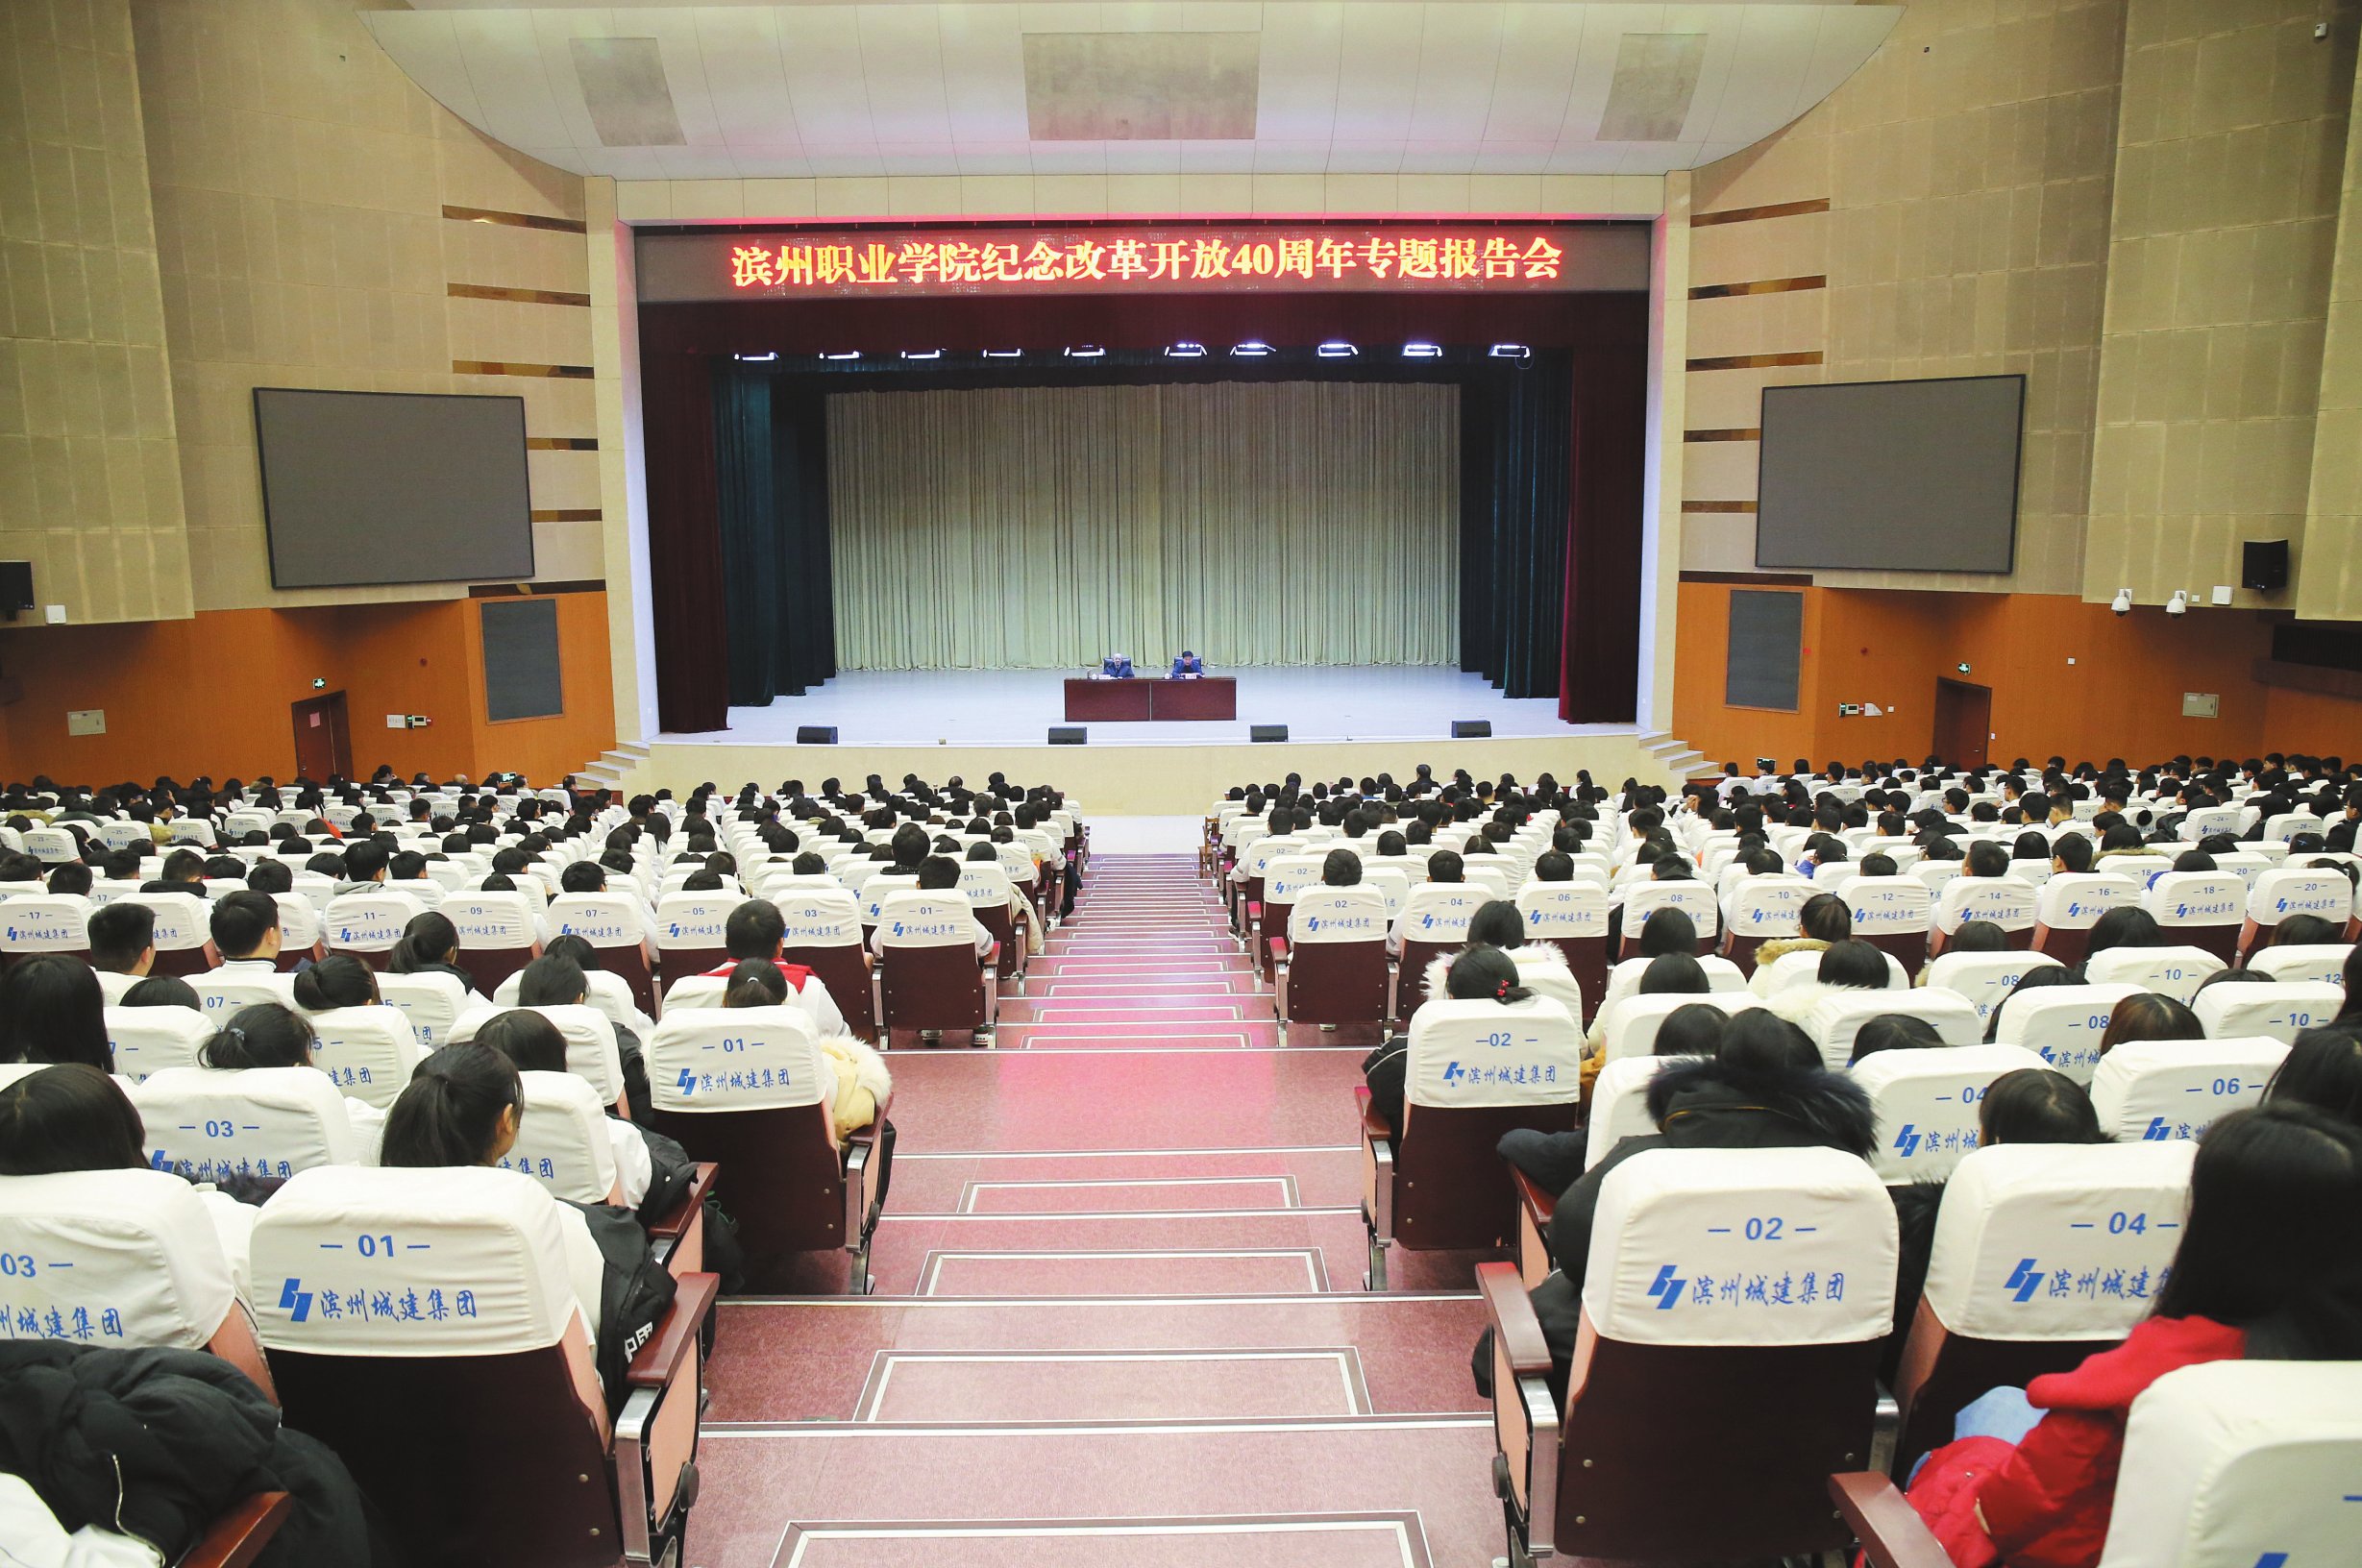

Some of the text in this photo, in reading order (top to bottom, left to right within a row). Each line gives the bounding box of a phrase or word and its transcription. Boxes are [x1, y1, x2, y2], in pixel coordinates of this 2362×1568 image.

[731, 236, 1562, 287] 滨州职业学院纪念改革开放40周年专题报告会
[1779, 891, 1790, 899] 10
[2204, 886, 2215, 894] 18
[1671, 894, 1684, 903] 08
[29, 911, 40, 919] 17
[471, 906, 482, 916] 09
[585, 909, 597, 918] 07
[692, 907, 705, 916] 05
[804, 909, 818, 918] 03
[920, 906, 932, 915] 01
[681, 924, 727, 937] 滨州城建集
[2002, 974, 2019, 987] 08
[2165, 968, 2182, 981] 10
[2325, 972, 2342, 985] 12
[207, 995, 224, 1009] 07
[2088, 1015, 2109, 1030] 08
[2289, 1013, 2310, 1027] 10
[723, 1038, 745, 1053] 01
[1489, 1032, 1512, 1047] 02
[701, 1067, 790, 1092] 滨州城建集团
[1467, 1064, 1557, 1087] 滨州城建集团
[2212, 1077, 2241, 1095] 06
[205, 1119, 235, 1138] 03
[1744, 1216, 1784, 1240] 02
[2107, 1212, 2148, 1236] 04
[357, 1234, 395, 1258] 01
[0, 1253, 37, 1278] 03
[1692, 1271, 1846, 1309] 滨州城建集团
[320, 1288, 478, 1323] 滨州城建集团
[0, 1304, 123, 1341] 州城建集团
